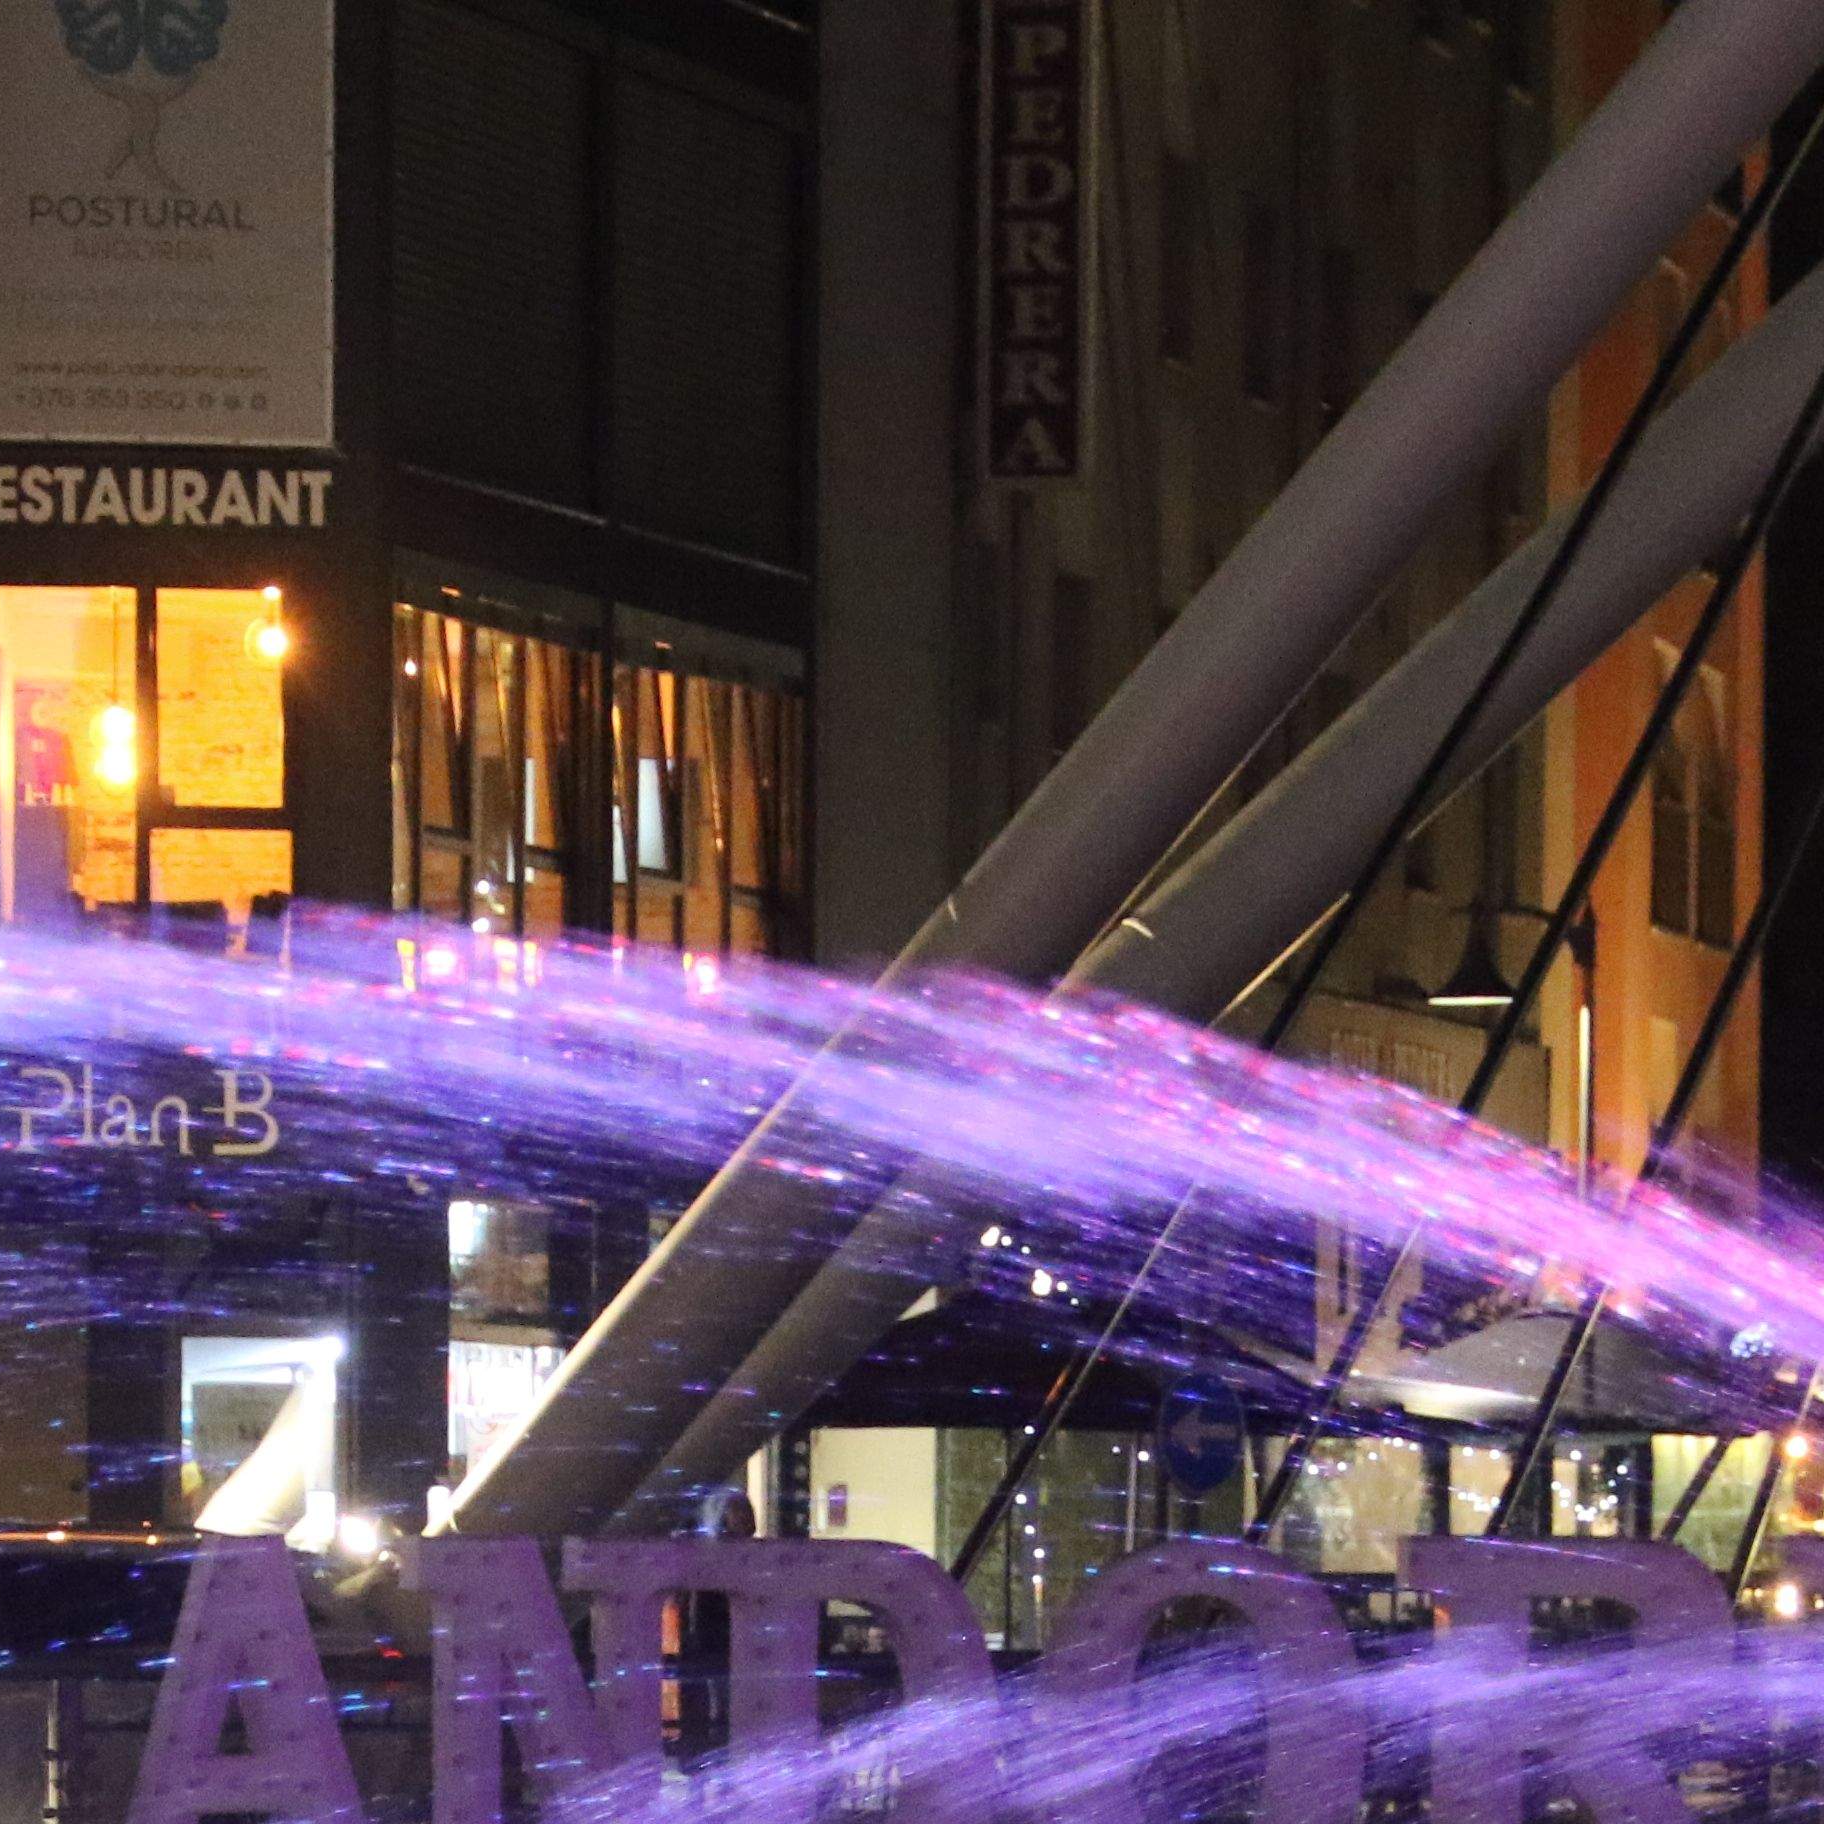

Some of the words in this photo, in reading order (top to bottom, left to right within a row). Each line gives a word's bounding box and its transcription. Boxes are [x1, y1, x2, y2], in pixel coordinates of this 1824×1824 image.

[28, 194, 256, 231] POSTURAL
[999, 22, 1075, 471] PEDRERA
[0, 1063, 194, 1156] Plan
[202, 1069, 280, 1156] B
